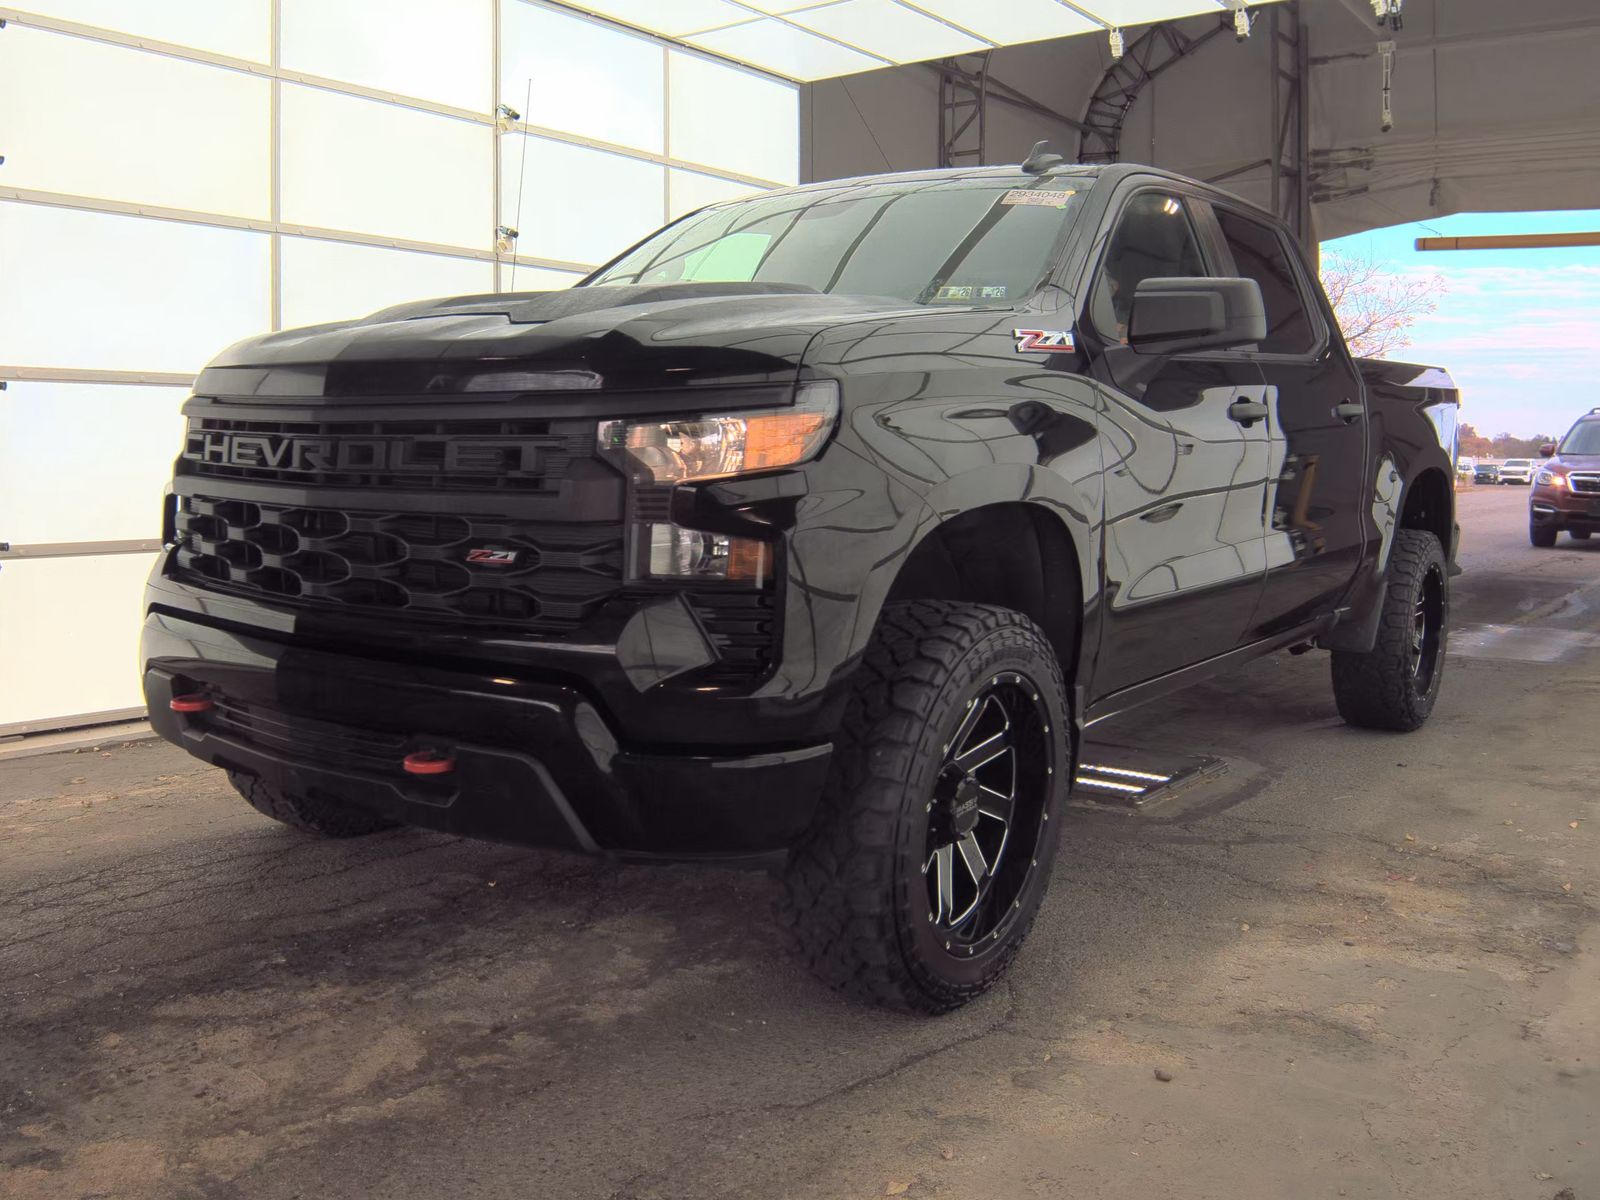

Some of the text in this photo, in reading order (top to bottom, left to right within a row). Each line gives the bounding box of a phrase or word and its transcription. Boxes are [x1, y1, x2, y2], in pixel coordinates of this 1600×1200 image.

[1008, 190, 1066, 199] 2934048
[1012, 328, 1075, 353] Z71
[183, 433, 562, 473] CHEVROLET
[466, 549, 517, 563] Z71
